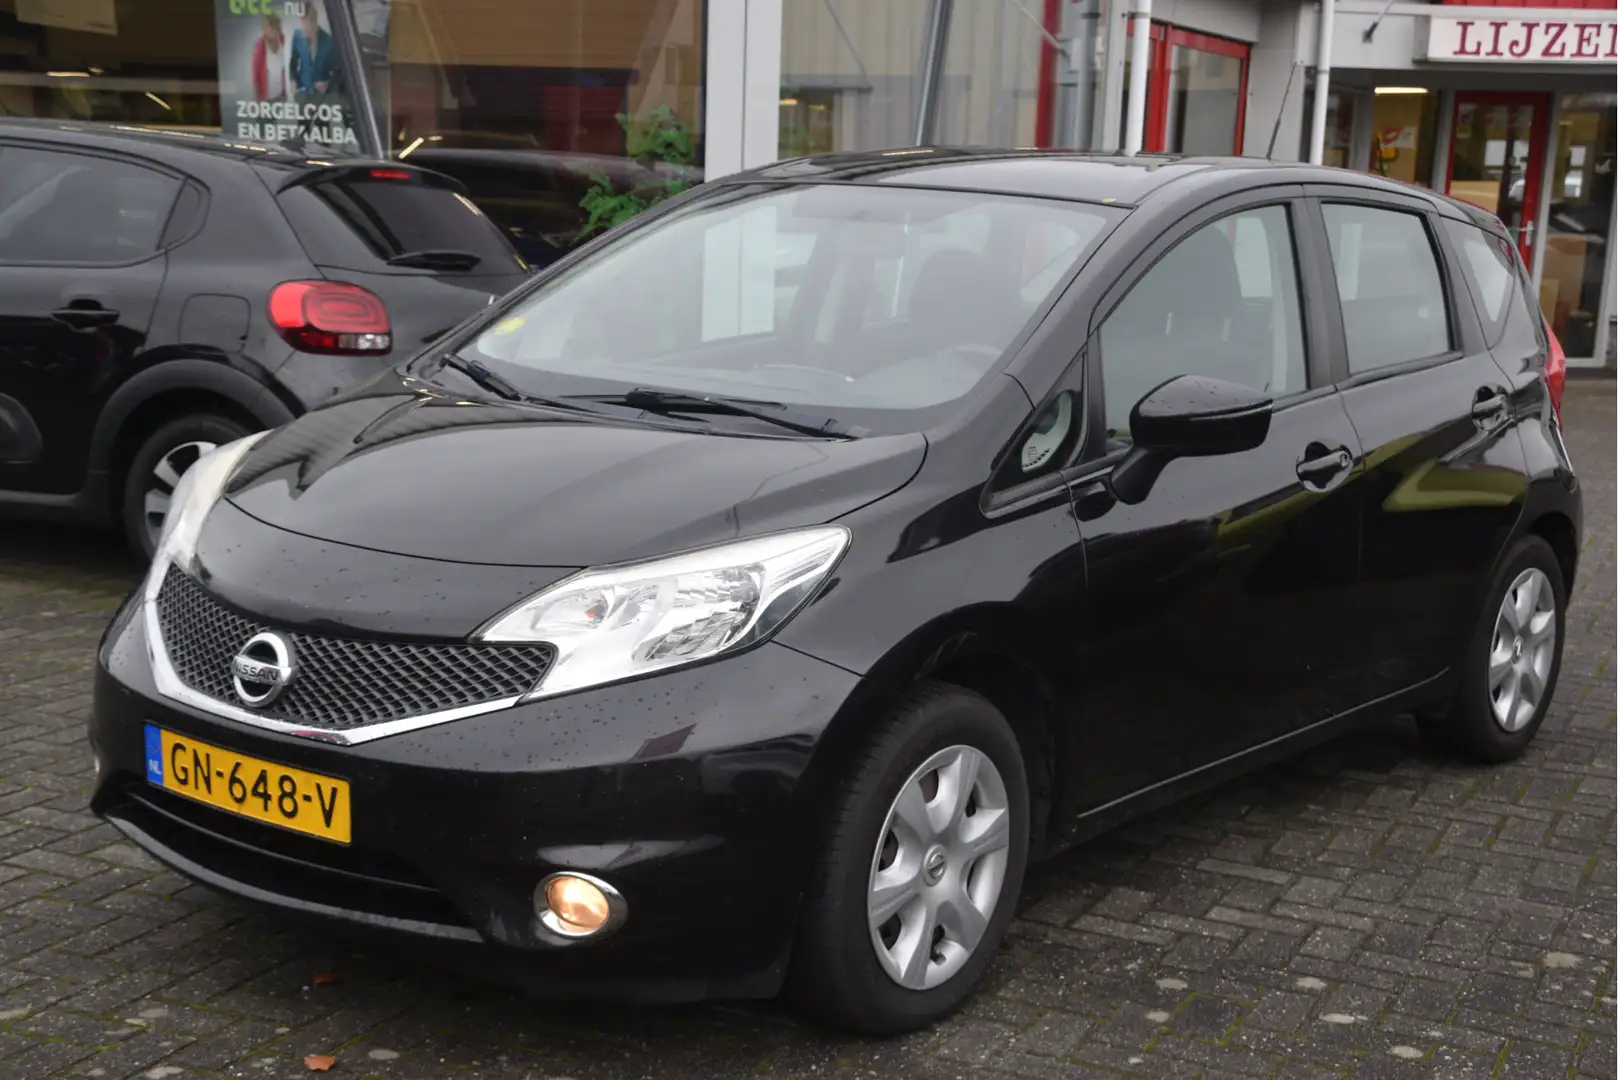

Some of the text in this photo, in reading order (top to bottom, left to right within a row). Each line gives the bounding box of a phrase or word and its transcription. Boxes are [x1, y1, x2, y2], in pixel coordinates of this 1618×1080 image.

[238, 122, 260, 139] EN
[235, 660, 278, 681] NISSAN
[149, 759, 161, 774] NL
[171, 742, 338, 829] GN-648-V
